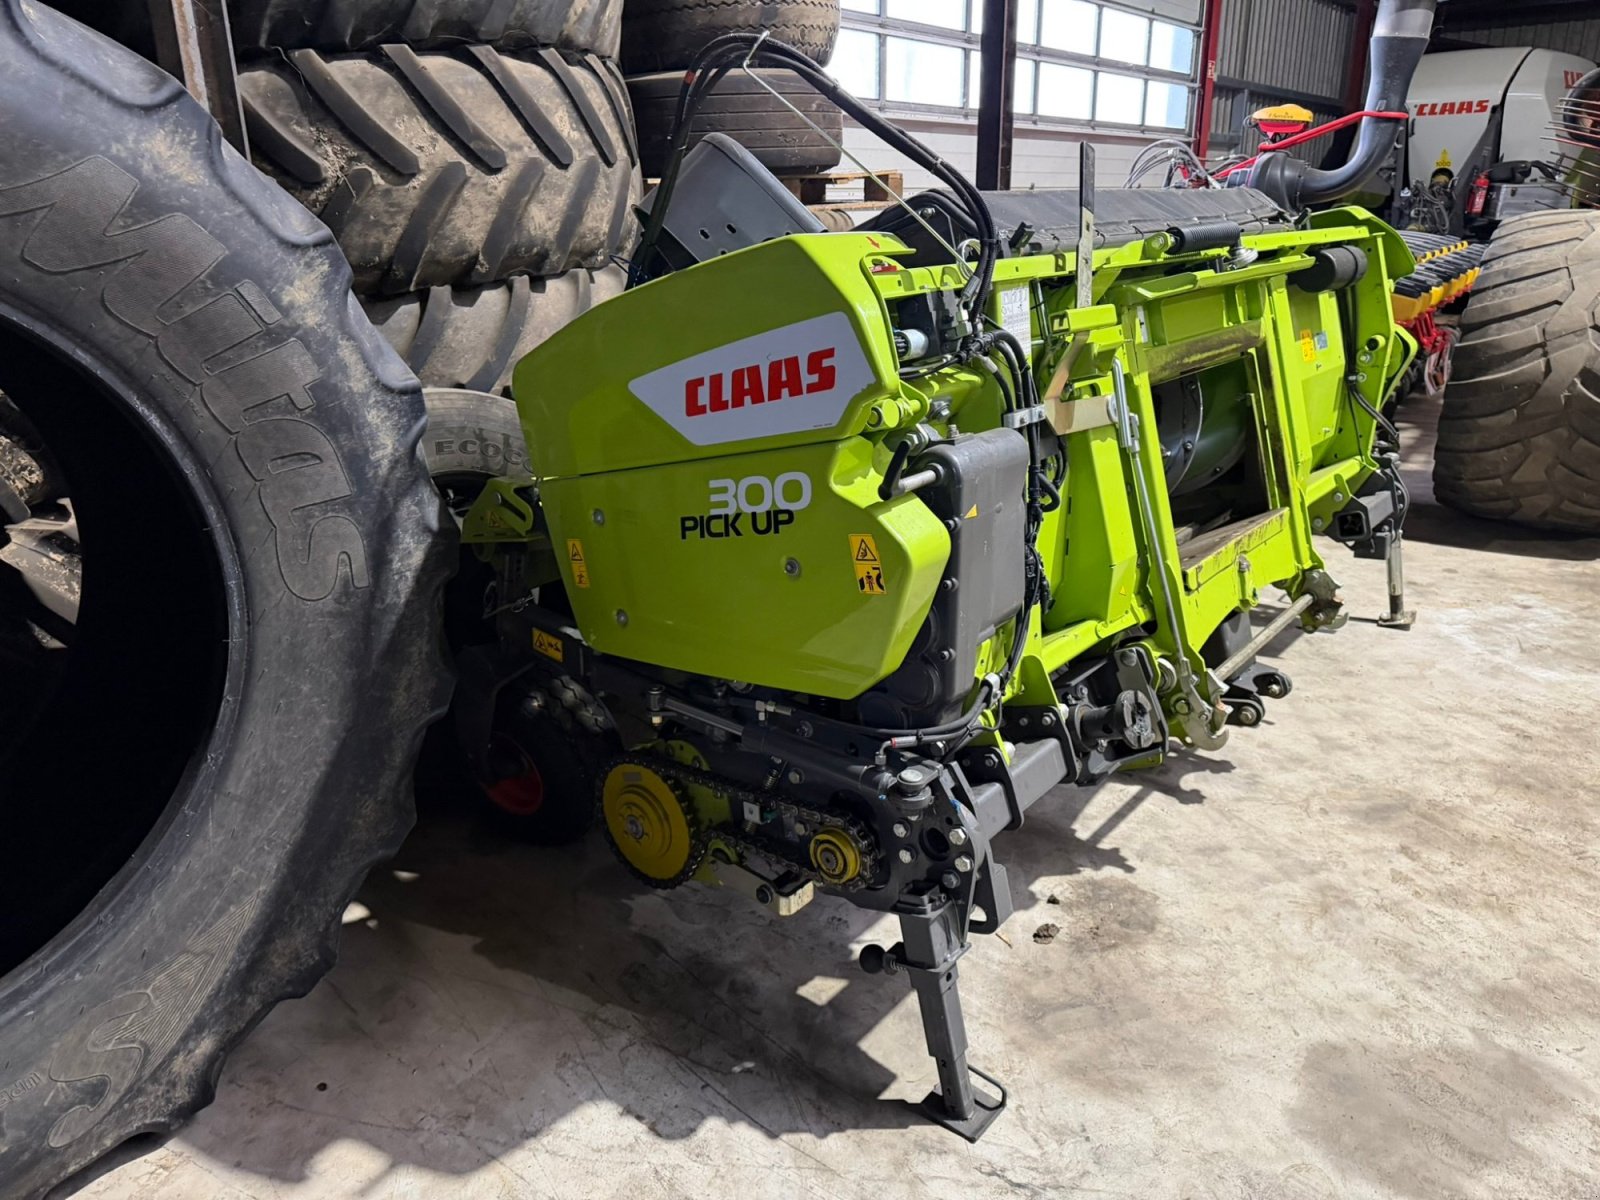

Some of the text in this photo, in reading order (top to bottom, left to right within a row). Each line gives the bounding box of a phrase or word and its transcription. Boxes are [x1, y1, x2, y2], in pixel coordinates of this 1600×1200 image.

[1416, 99, 1490, 117] CLAAS
[685, 346, 836, 418] CLAAS
[708, 471, 812, 515] 300
[680, 508, 795, 540] PICK UP
